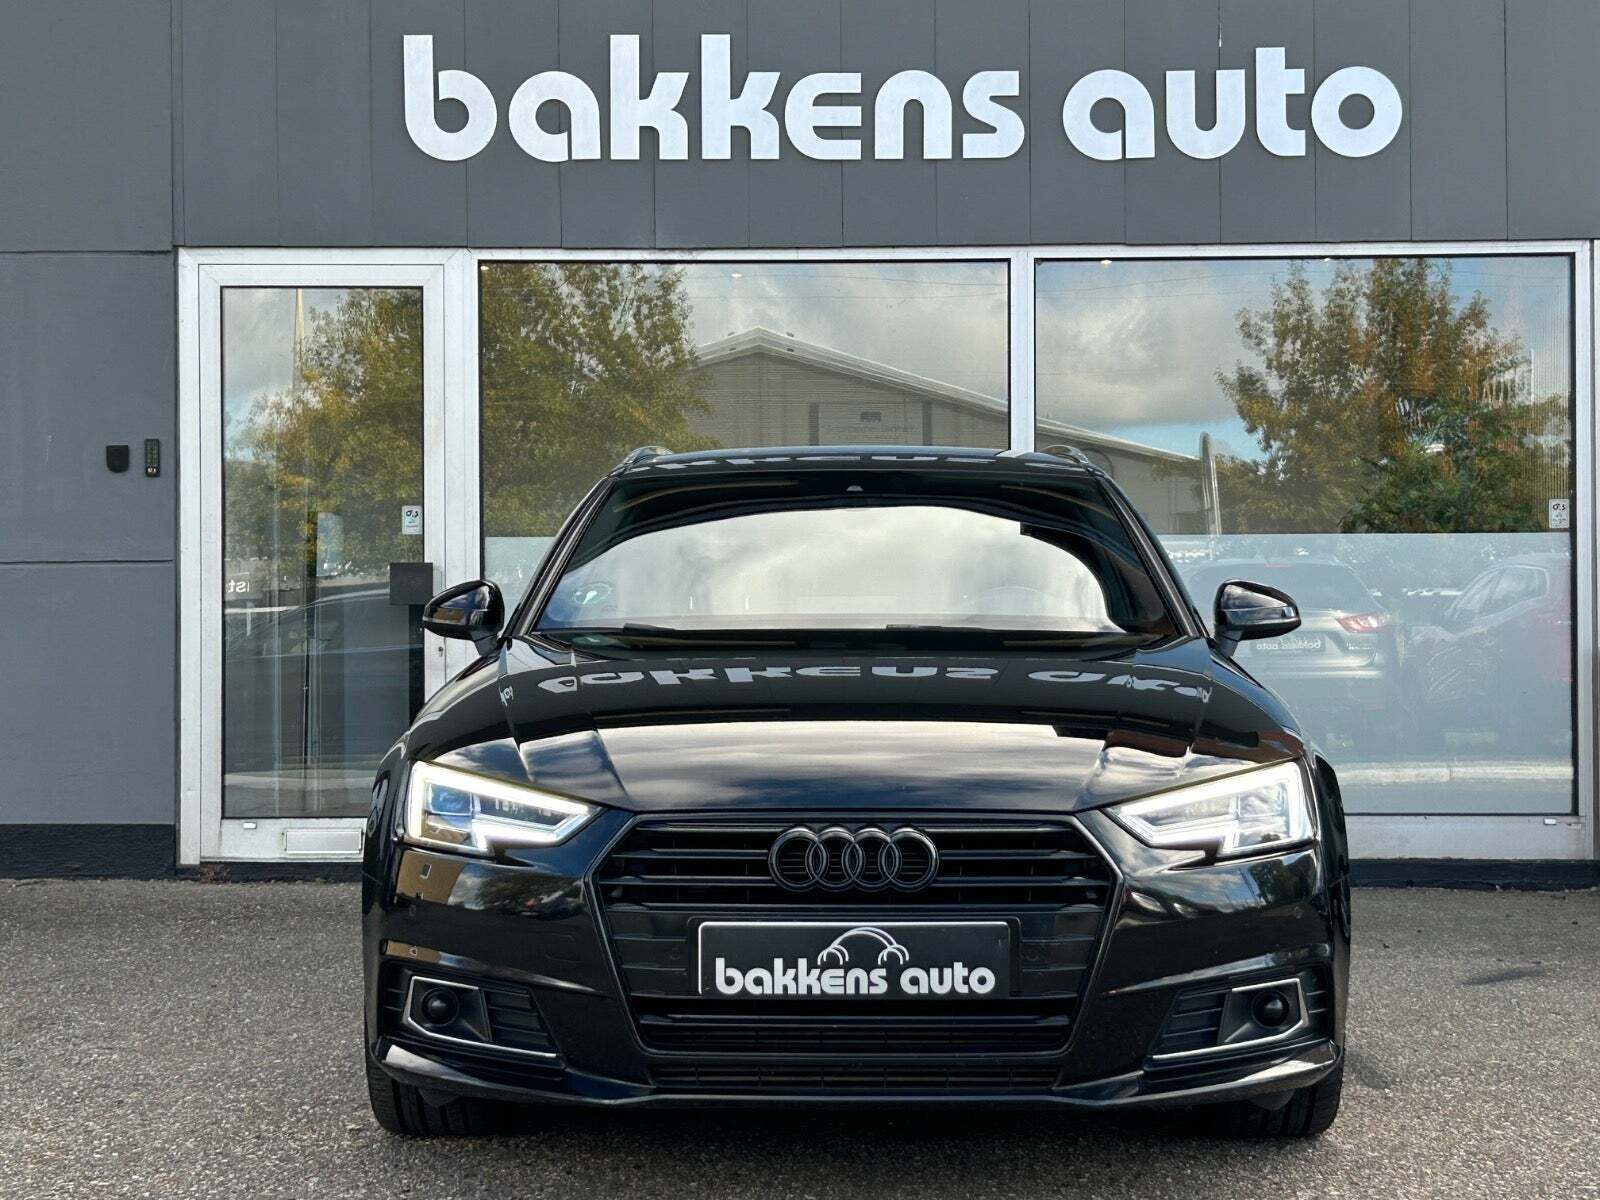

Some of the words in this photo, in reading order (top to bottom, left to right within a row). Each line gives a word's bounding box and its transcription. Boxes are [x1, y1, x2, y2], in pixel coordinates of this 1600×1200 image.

[404, 34, 1025, 162] bakkens
[1063, 46, 1403, 162] auto
[715, 957, 888, 995] bakkens
[899, 962, 996, 995] auto
